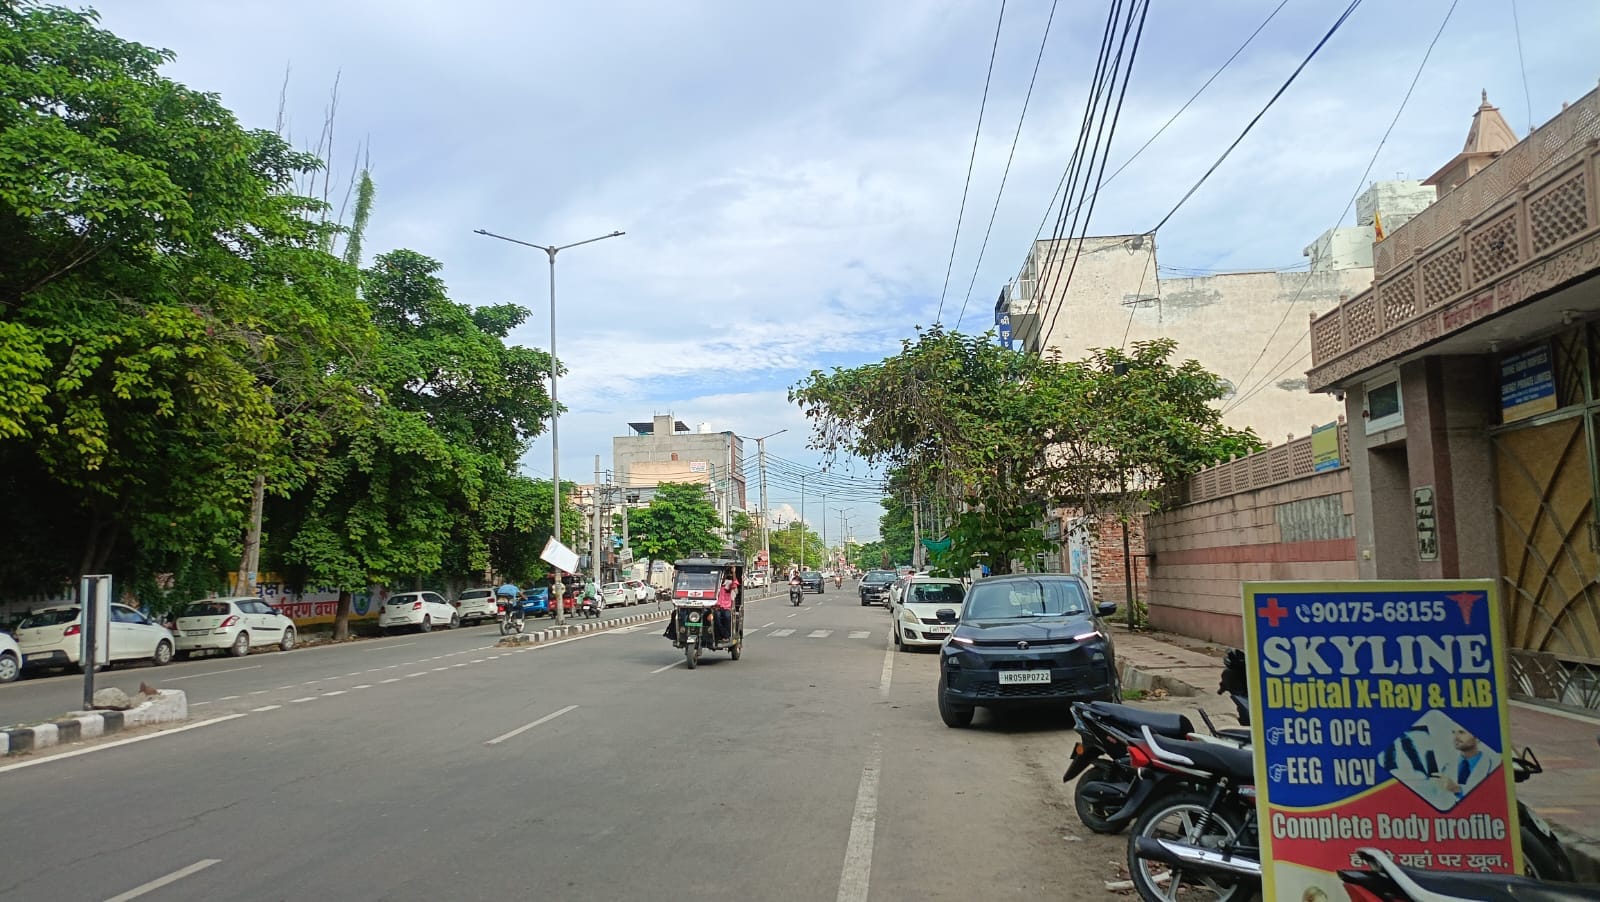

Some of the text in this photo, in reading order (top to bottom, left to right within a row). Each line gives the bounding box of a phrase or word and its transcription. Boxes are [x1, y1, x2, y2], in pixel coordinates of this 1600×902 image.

[1311, 601, 1447, 623] 90175-68155
[1263, 635, 1490, 675] SKYLINE
[1266, 677, 1493, 712] Digital X-Ray & LAB
[1283, 717, 1372, 746] ECG OPG
[1287, 757, 1376, 786] EEG NCV
[1272, 812, 1506, 842] Complete Body profile
[1438, 853, 1461, 867] पर
